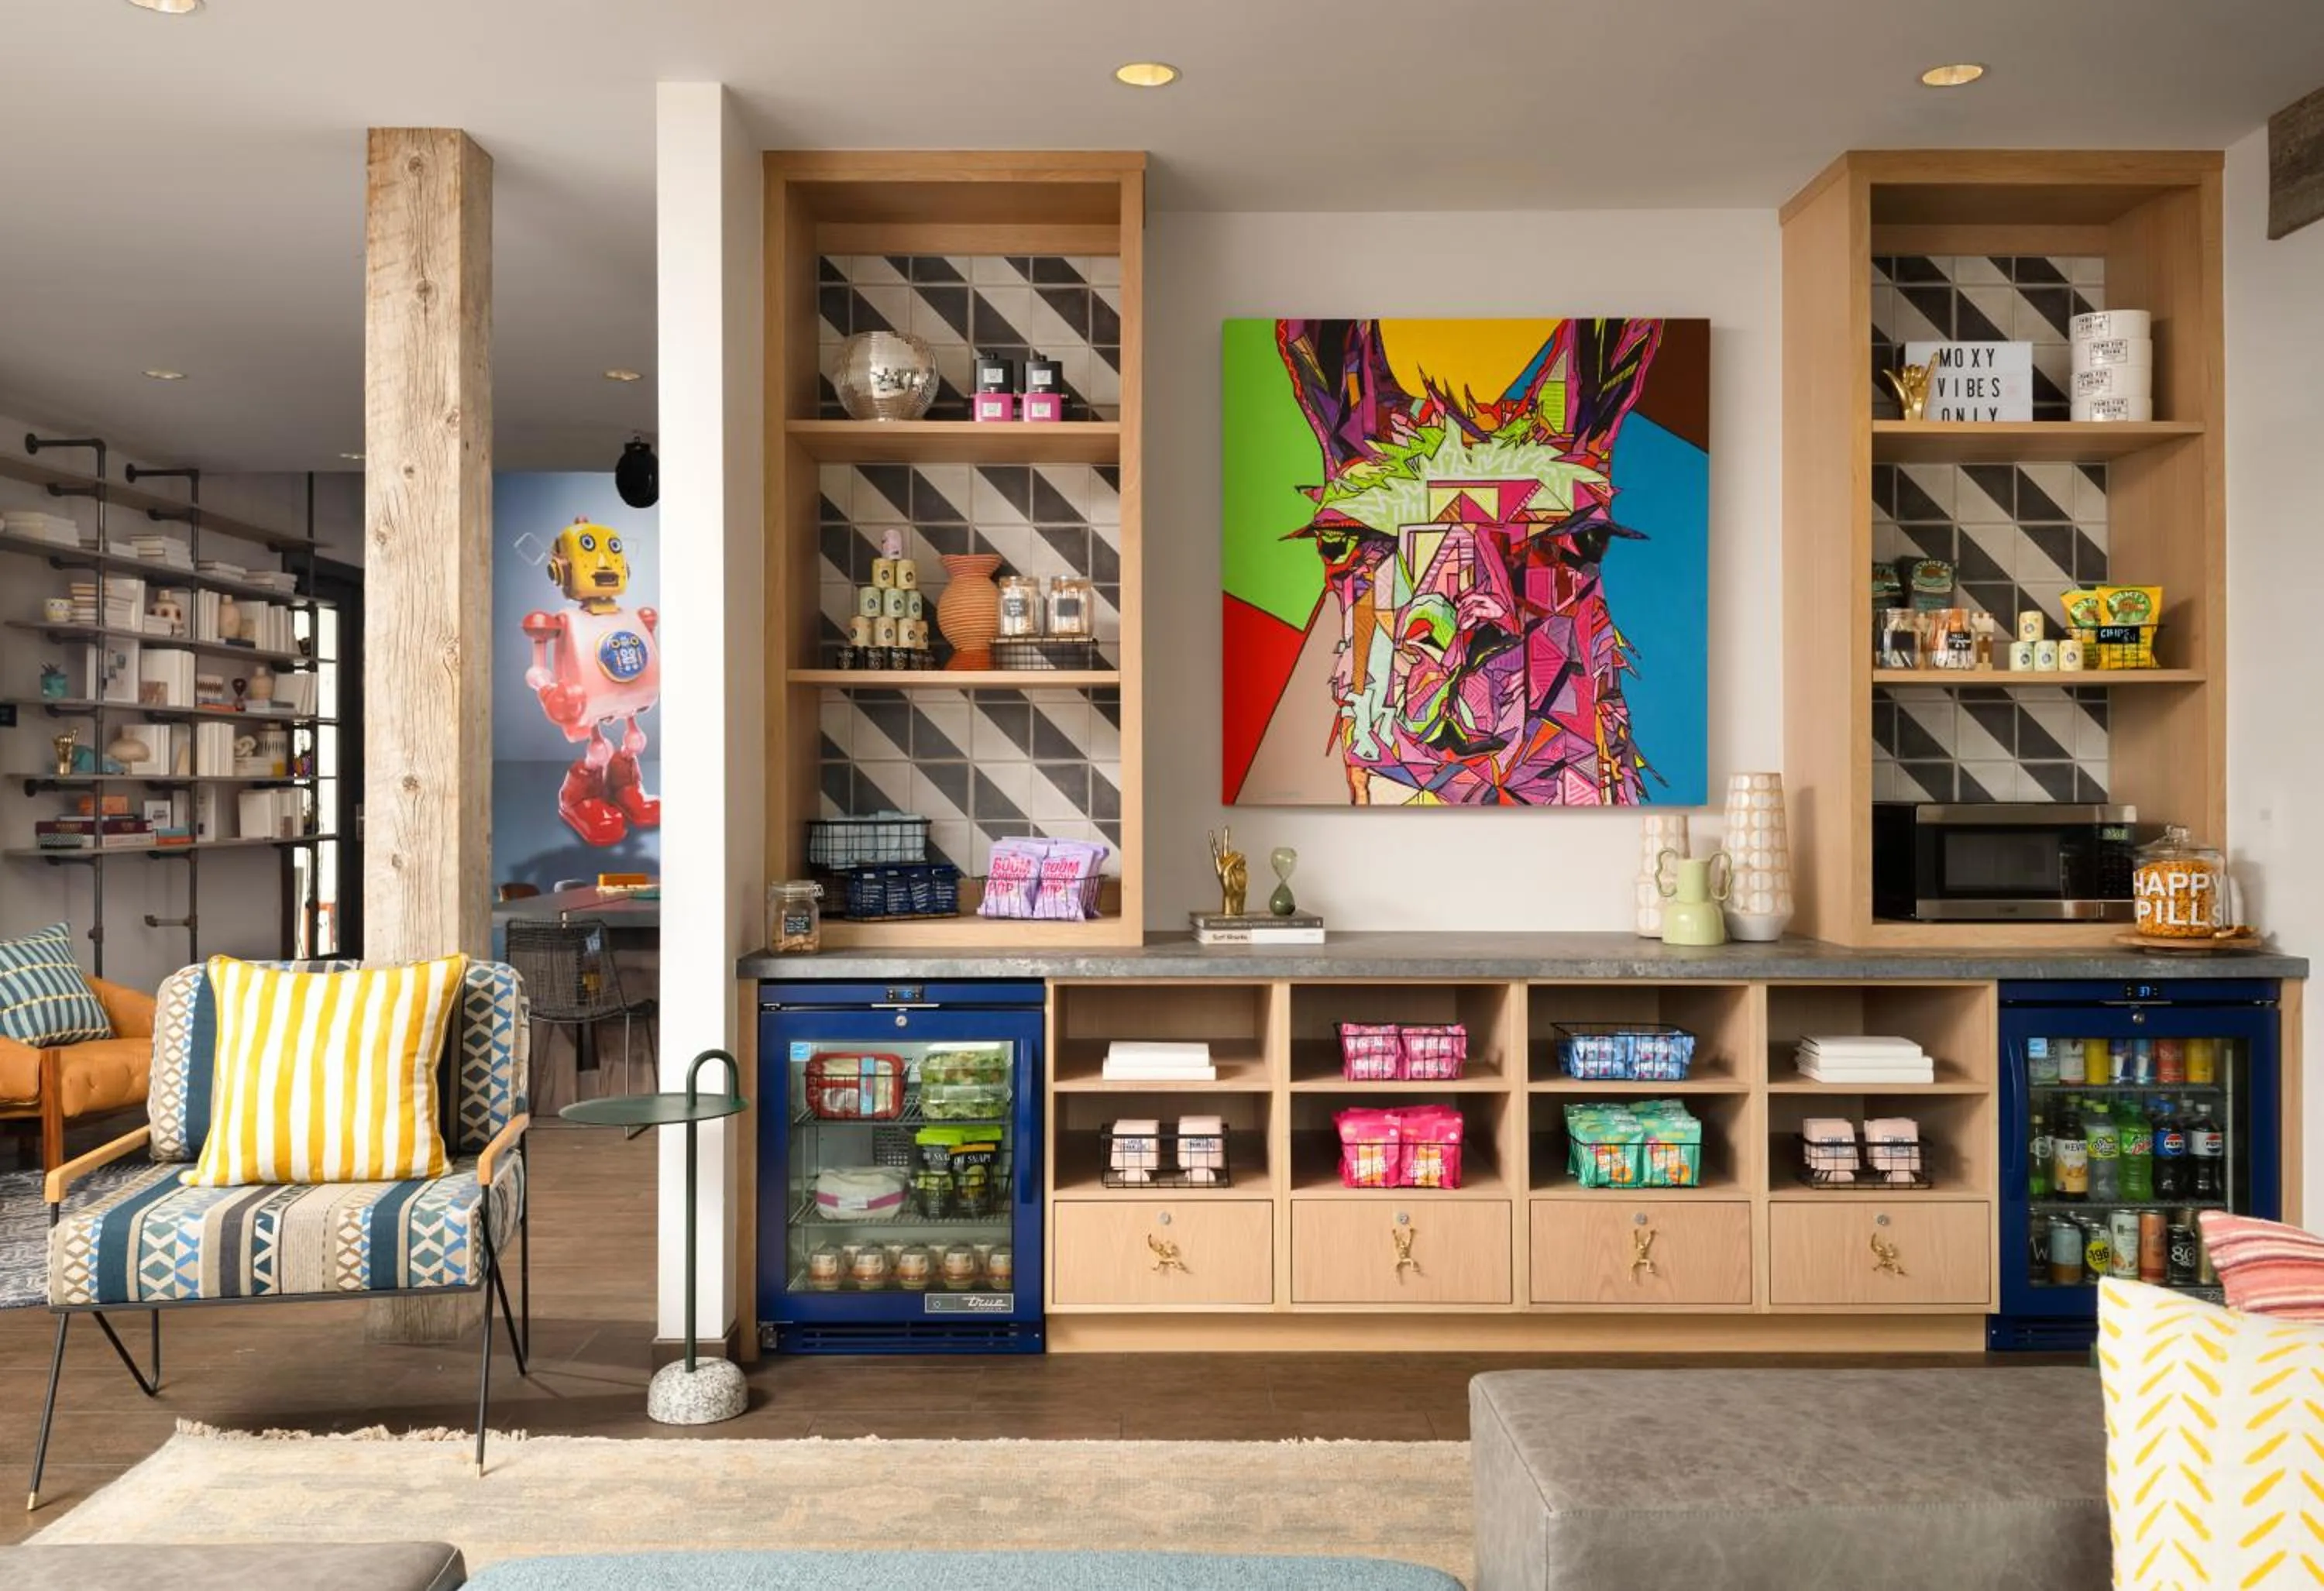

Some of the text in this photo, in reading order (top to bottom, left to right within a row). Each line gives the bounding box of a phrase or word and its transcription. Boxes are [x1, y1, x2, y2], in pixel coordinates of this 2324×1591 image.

[1939, 348, 1995, 368] MOXY
[1937, 377, 2000, 397] VIBES
[2100, 628, 2130, 639] CHIPS
[2133, 871, 2223, 897] HAPPY
[2137, 899, 2222, 927] PILLS
[961, 1295, 1009, 1307] True
